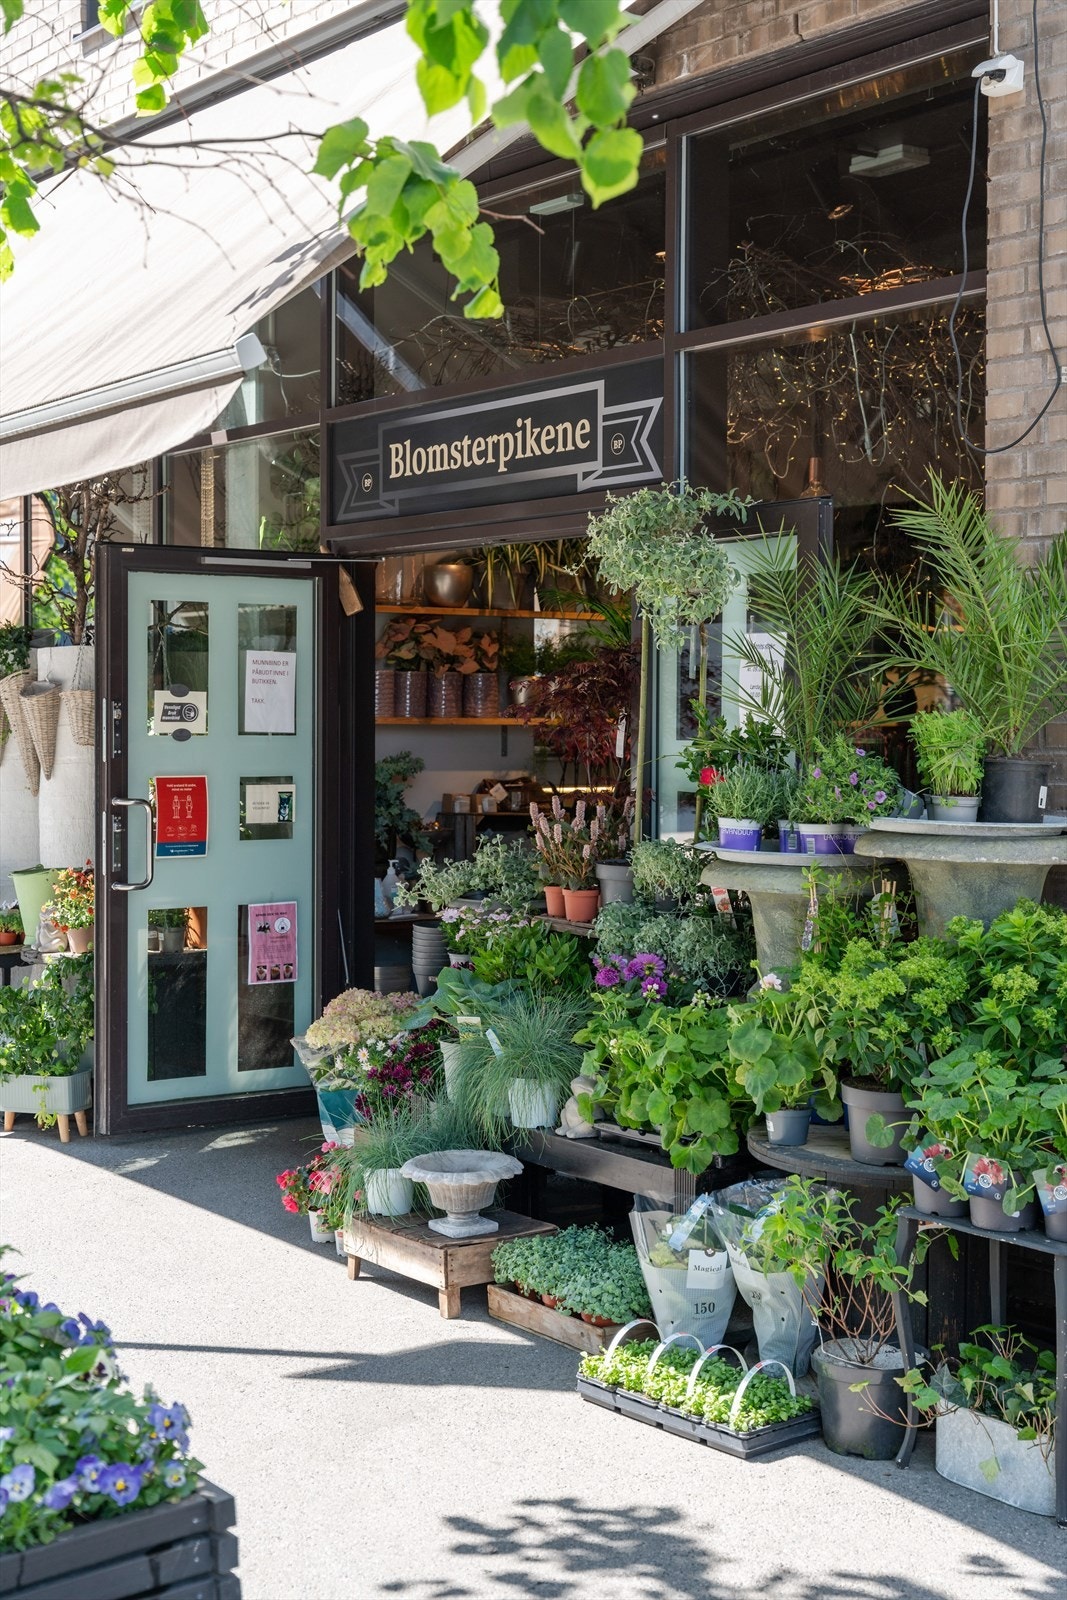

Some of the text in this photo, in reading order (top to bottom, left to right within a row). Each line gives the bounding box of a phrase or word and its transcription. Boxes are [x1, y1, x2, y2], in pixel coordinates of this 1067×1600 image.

[389, 417, 591, 479] Blomsterpikene
[612, 440, 623, 449] BP
[364, 479, 372, 487] BP
[252, 668, 272, 676] PÅBUDT
[693, 1264, 723, 1273] Magical
[694, 1302, 716, 1315] 150
